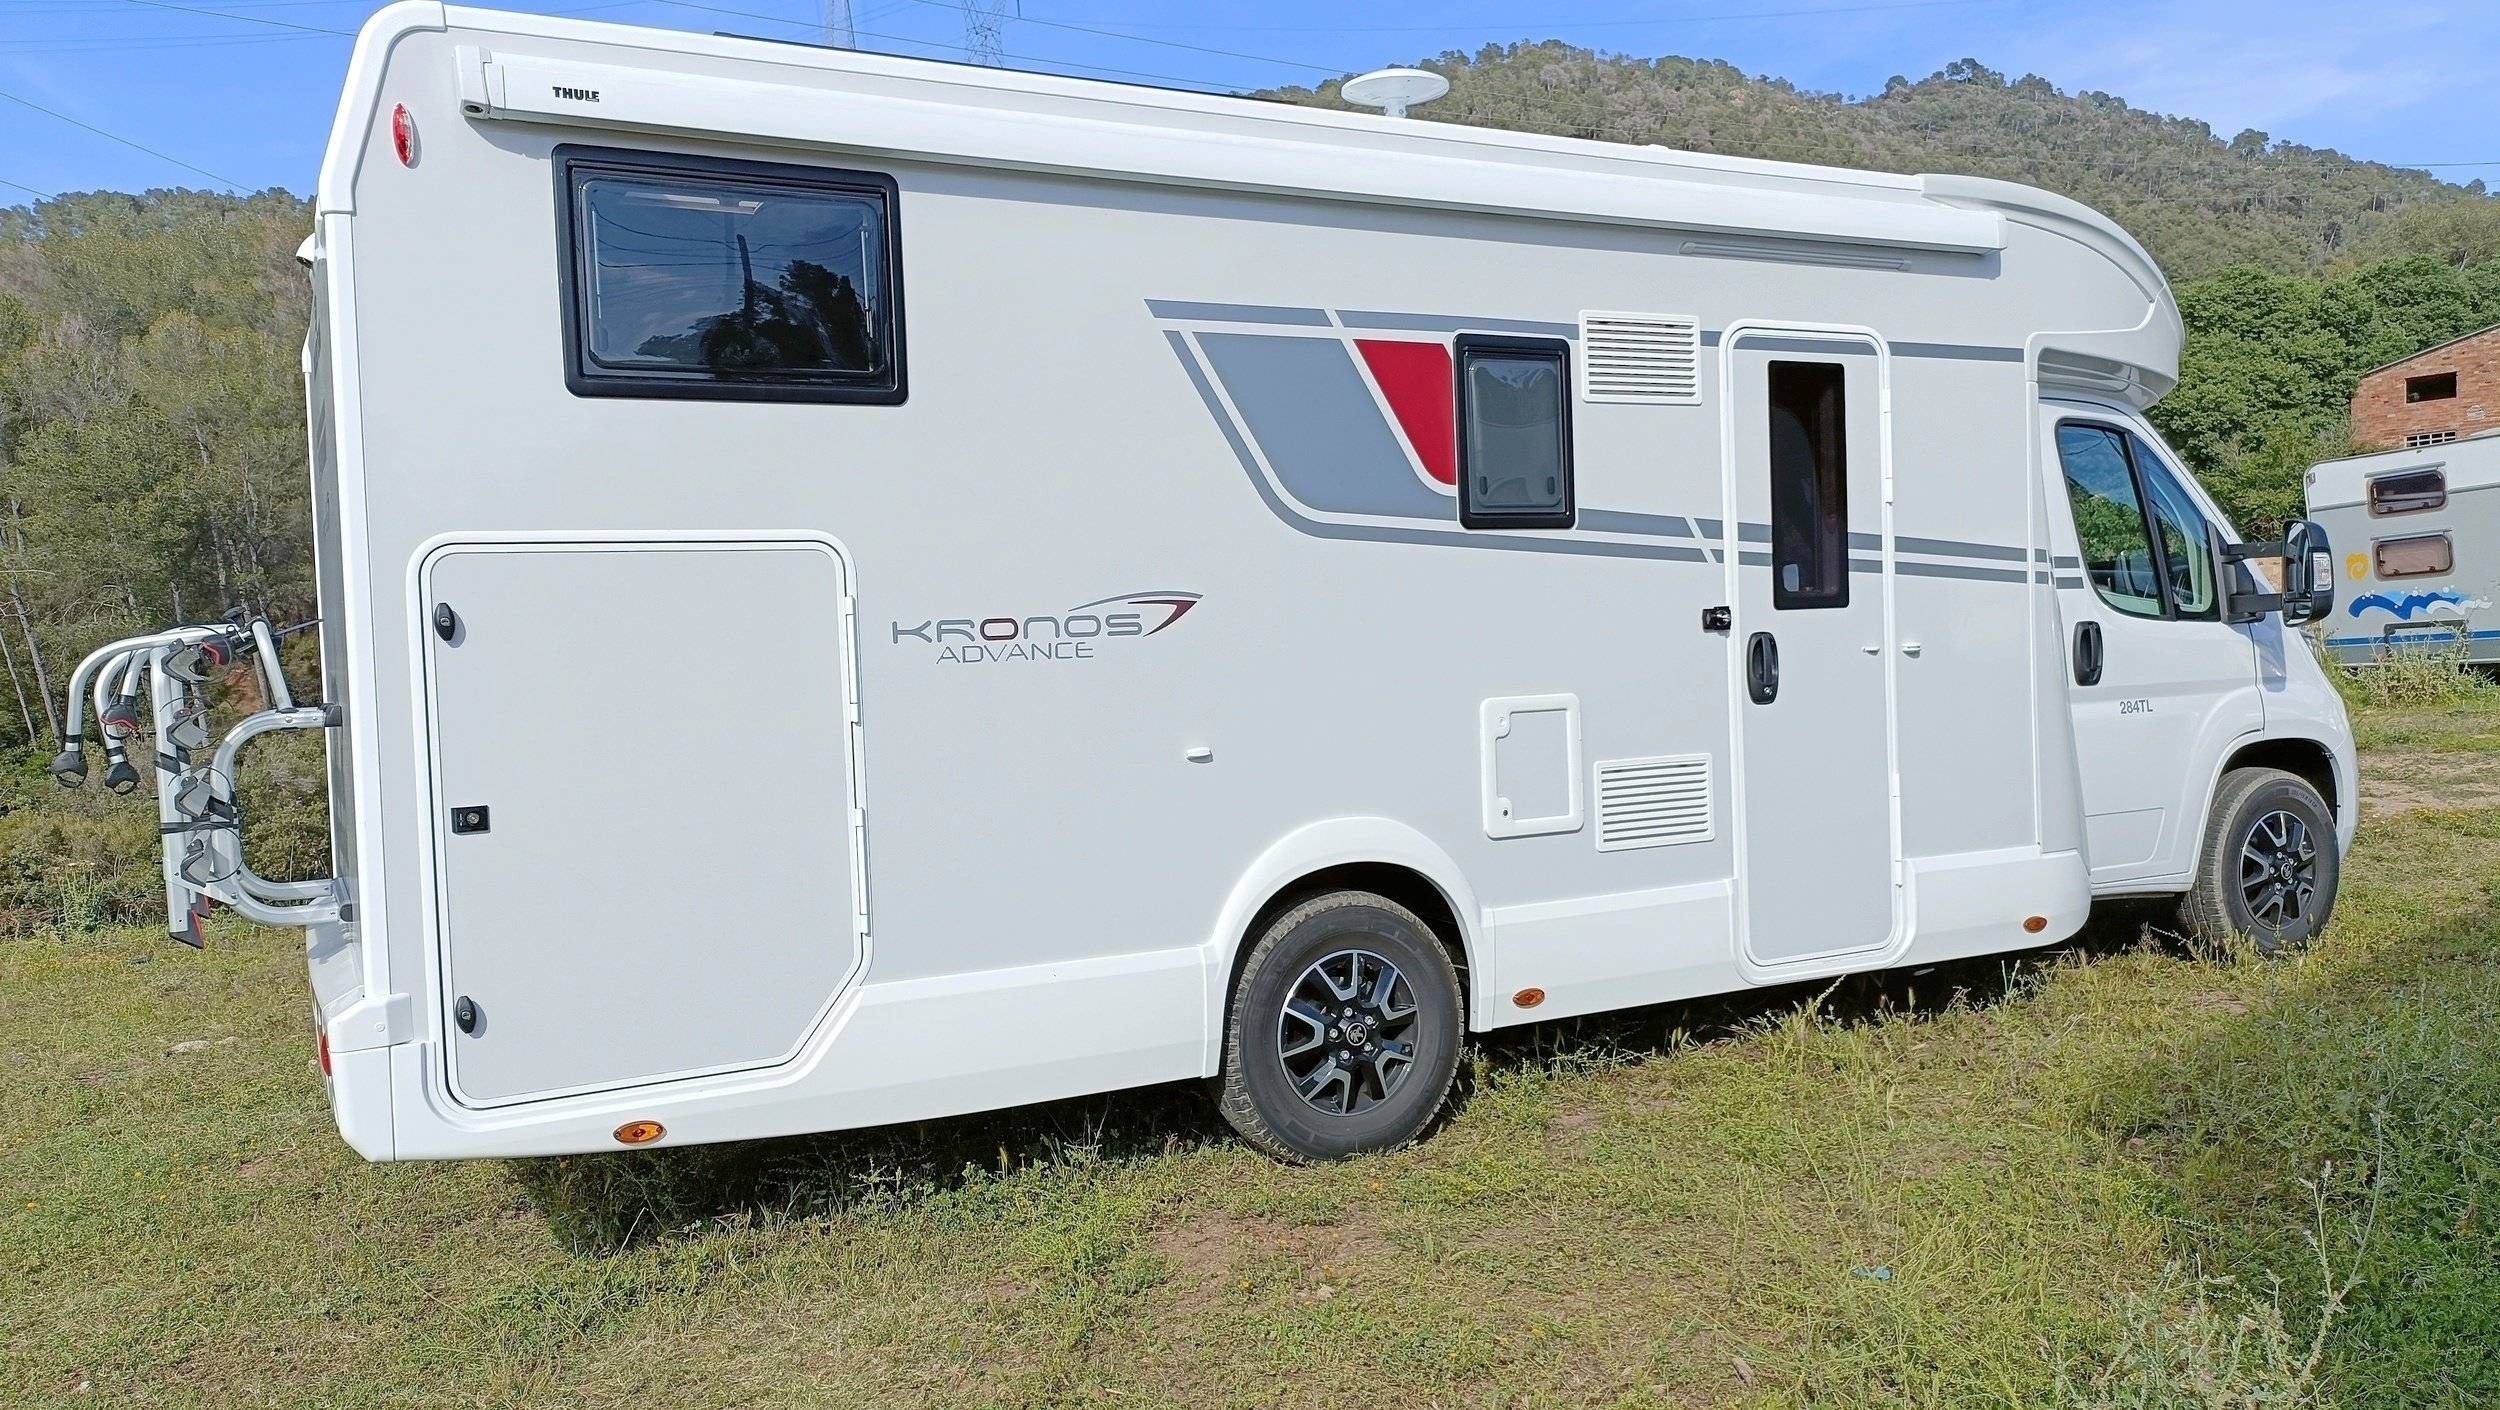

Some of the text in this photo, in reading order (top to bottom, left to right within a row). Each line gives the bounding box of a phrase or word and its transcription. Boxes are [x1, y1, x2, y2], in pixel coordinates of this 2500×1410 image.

[552, 86, 600, 103] THULE
[891, 613, 1143, 644] KRONOS
[935, 641, 1095, 665] ADVANCE
[2119, 699, 2154, 714] 284TL
